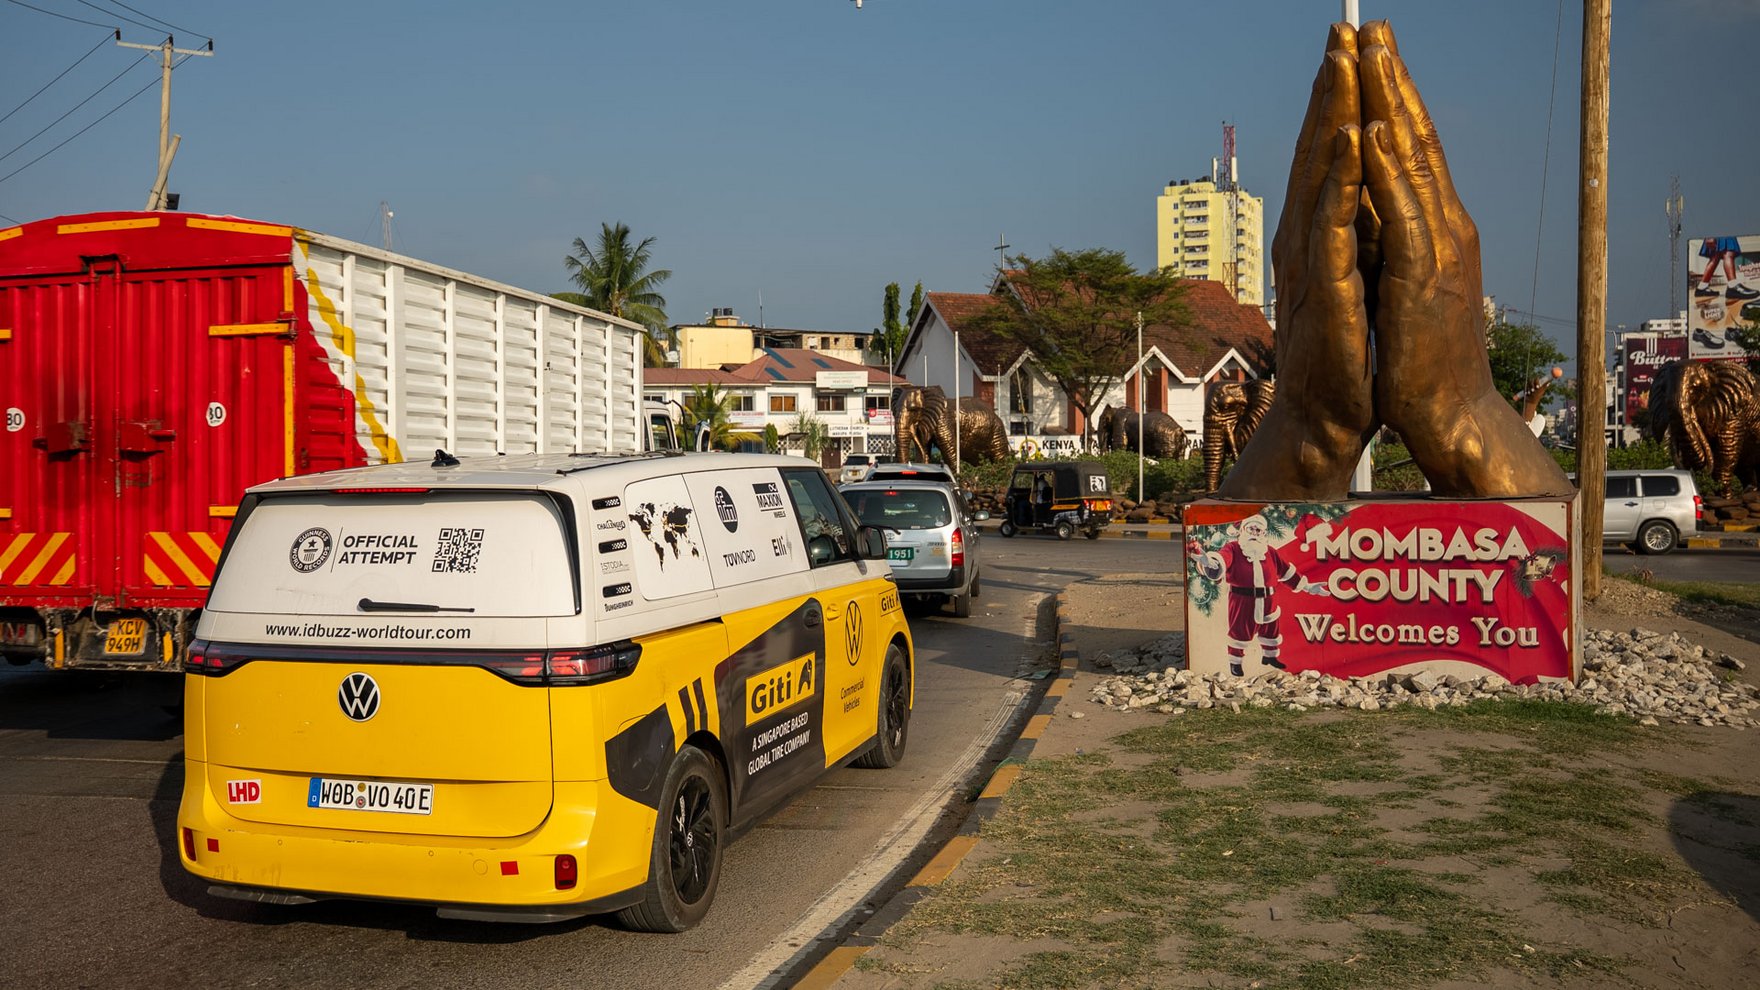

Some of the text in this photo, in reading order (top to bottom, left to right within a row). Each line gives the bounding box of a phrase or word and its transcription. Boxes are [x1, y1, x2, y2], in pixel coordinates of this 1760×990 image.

[1042, 440, 1075, 450] KENYA
[756, 493, 783, 508] MAXION
[293, 530, 330, 571] GUINNESS WORLD RECORDS
[343, 535, 418, 548] OFFICIAL
[1315, 525, 1533, 562] MOMBASA
[338, 551, 417, 564] ATTEMPT
[889, 549, 912, 559] 1951
[1327, 567, 1504, 602] COUNTY
[881, 594, 895, 611] Giti
[117, 621, 143, 636] KCV
[265, 623, 471, 640] www.idbuzz-worldtour.com
[1295, 612, 1540, 648] Welcomes You
[108, 638, 140, 652] 949H
[751, 671, 791, 714] Giti
[752, 712, 809, 752] A SINGAPORE BASED
[748, 729, 811, 775] GLOBAL TIRE COMPANY
[228, 780, 260, 803] LHD
[321, 781, 354, 806] WOB
